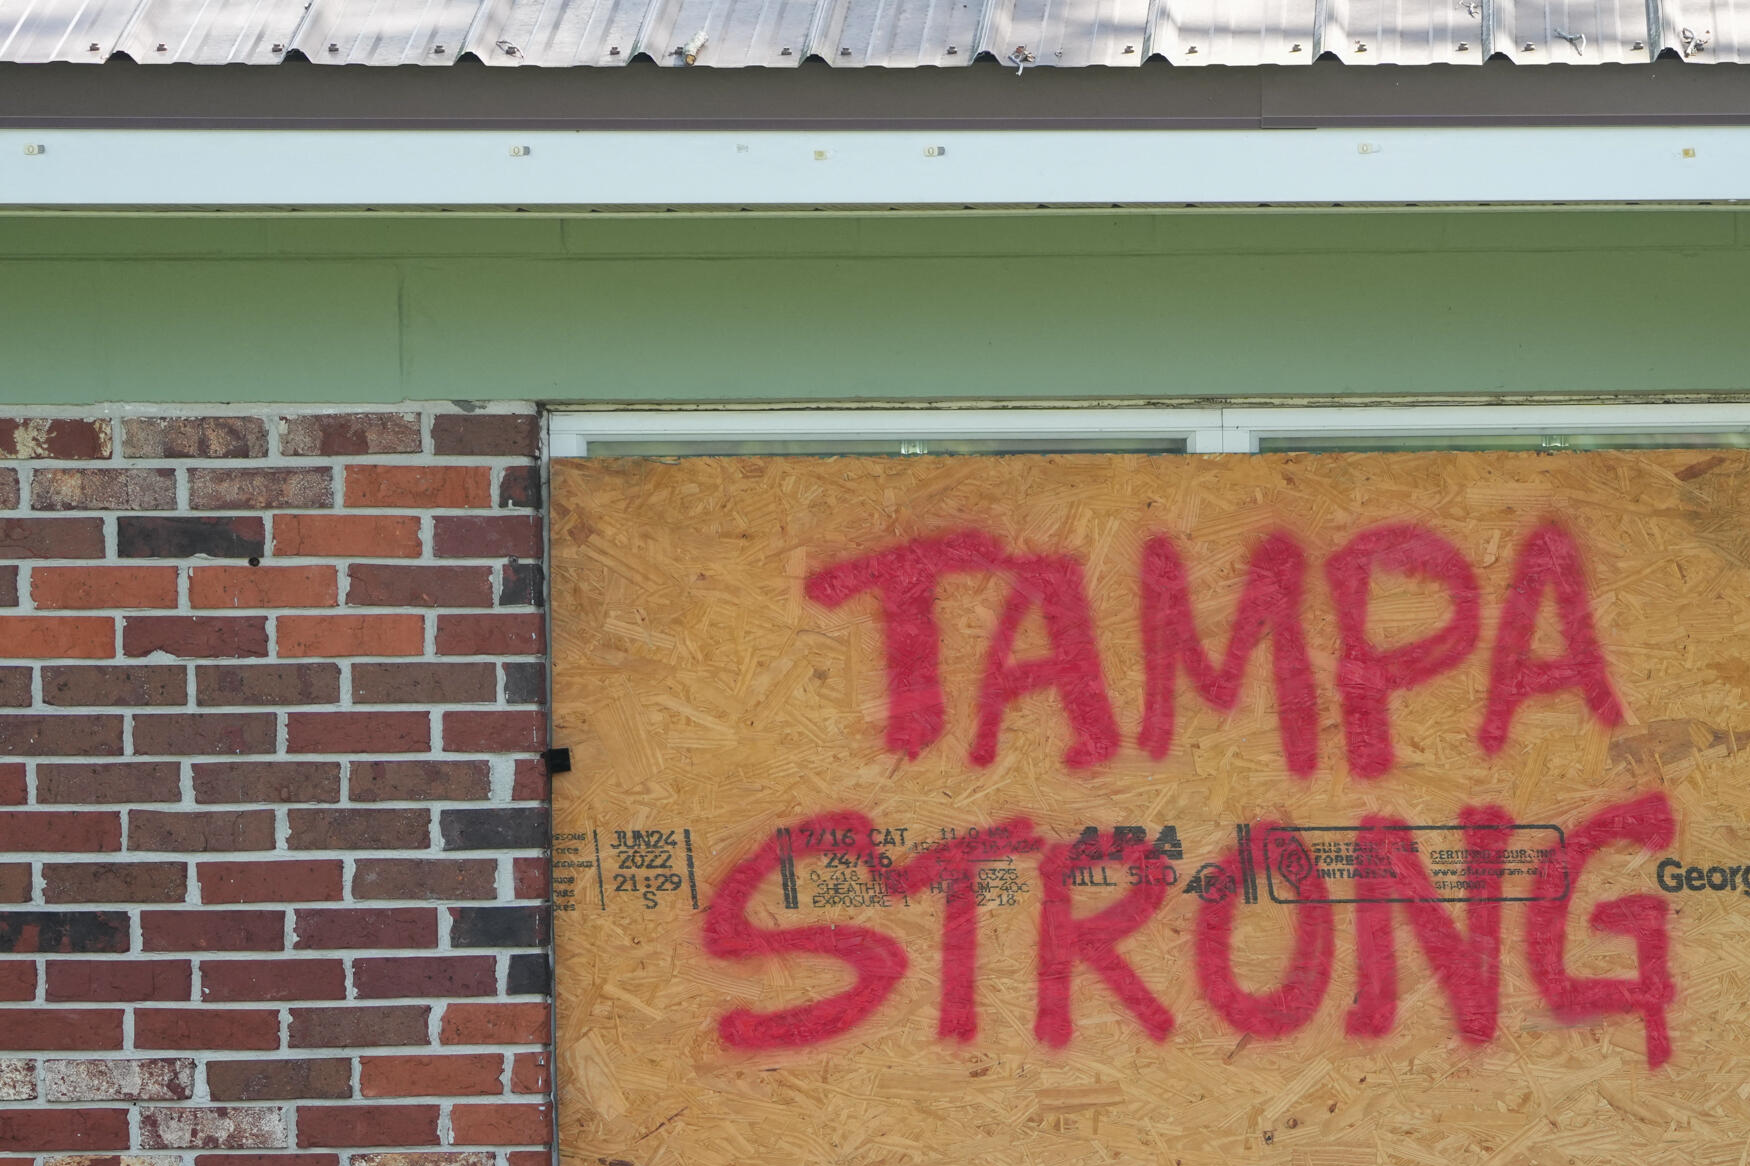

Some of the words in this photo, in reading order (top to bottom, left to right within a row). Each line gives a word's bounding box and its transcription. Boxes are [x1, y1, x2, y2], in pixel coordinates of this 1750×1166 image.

[804, 513, 1625, 782] TAMPA
[610, 830, 678, 849] JUN24
[800, 828, 856, 847] 7/16
[867, 828, 908, 846] CAT
[1066, 825, 1184, 861] APA
[616, 849, 673, 869] 2022
[823, 849, 893, 868] 24/16
[613, 873, 682, 892] 21:29
[810, 870, 860, 883] 0.418
[1061, 866, 1118, 887] MILL
[812, 895, 892, 907] EXPOSURE
[903, 895, 911, 907] 1
[976, 894, 1017, 907] 2-18
[699, 791, 1681, 1070] STRONG
